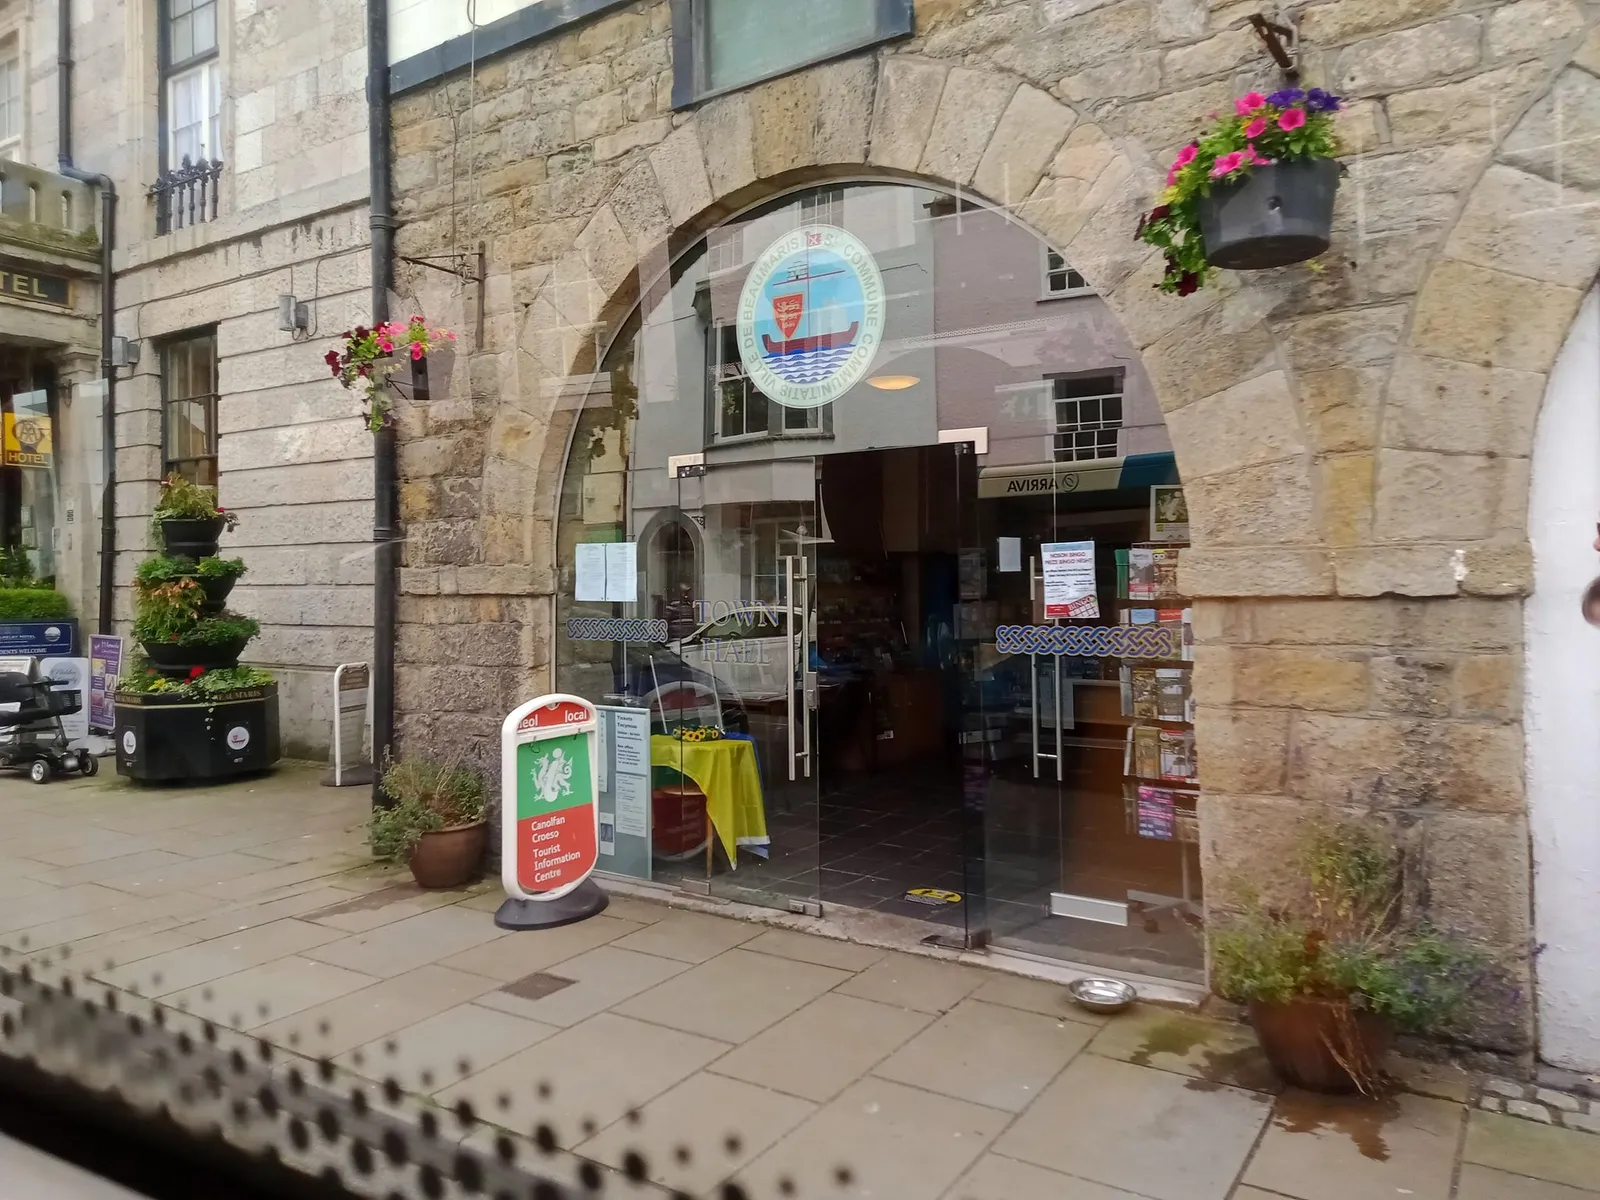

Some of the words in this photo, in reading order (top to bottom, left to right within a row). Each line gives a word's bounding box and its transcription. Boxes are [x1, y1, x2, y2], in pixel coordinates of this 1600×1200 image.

[744, 237, 800, 318] BEAUMARIS
[843, 244, 878, 328] COMMUNE
[743, 327, 755, 349] DE
[748, 353, 775, 389] VILLE
[780, 333, 873, 399] COMMUNITATIS
[8, 451, 49, 465] HOTEL
[1067, 596, 1092, 611] BINGO
[692, 599, 780, 628] TOWN
[564, 709, 587, 723] local
[531, 816, 566, 831] Canolfan
[531, 830, 560, 843] Croeso
[532, 843, 561, 859] Tourist
[533, 851, 581, 871] Information
[534, 868, 562, 883] Centre
